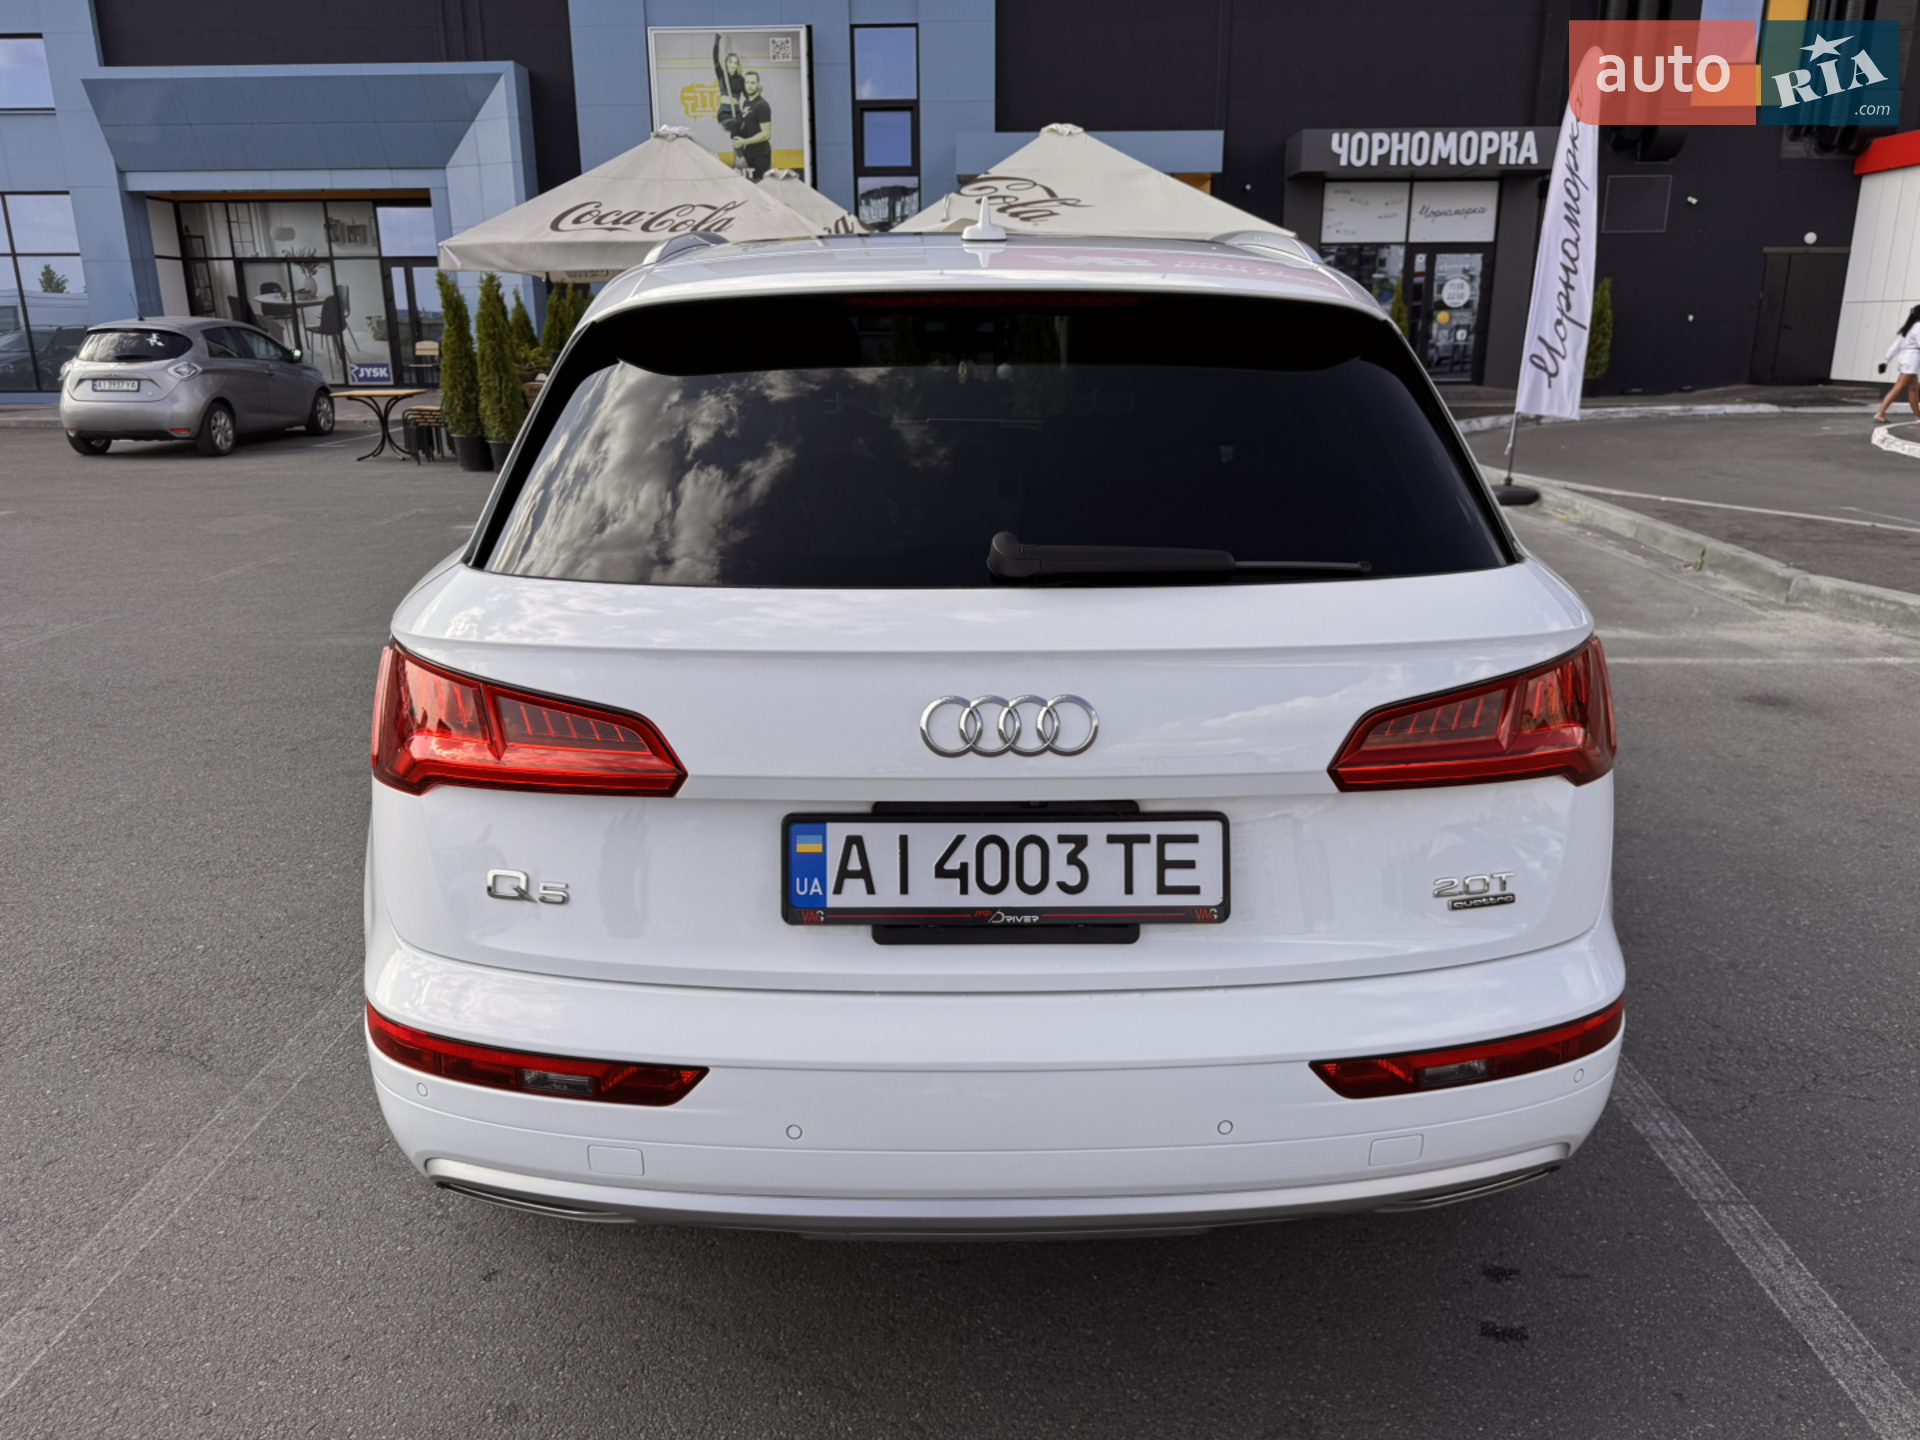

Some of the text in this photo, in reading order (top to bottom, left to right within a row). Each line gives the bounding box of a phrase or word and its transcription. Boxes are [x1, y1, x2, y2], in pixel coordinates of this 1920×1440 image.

[1331, 131, 1539, 167] ЧОРНОМОРКА
[550, 200, 749, 233] Coca-Cola
[359, 367, 389, 378] JYSK
[832, 834, 1201, 895] AI 4003 TE
[796, 877, 823, 896] UA
[1433, 871, 1515, 898] 2.0T
[1453, 895, 1514, 910] quattro
